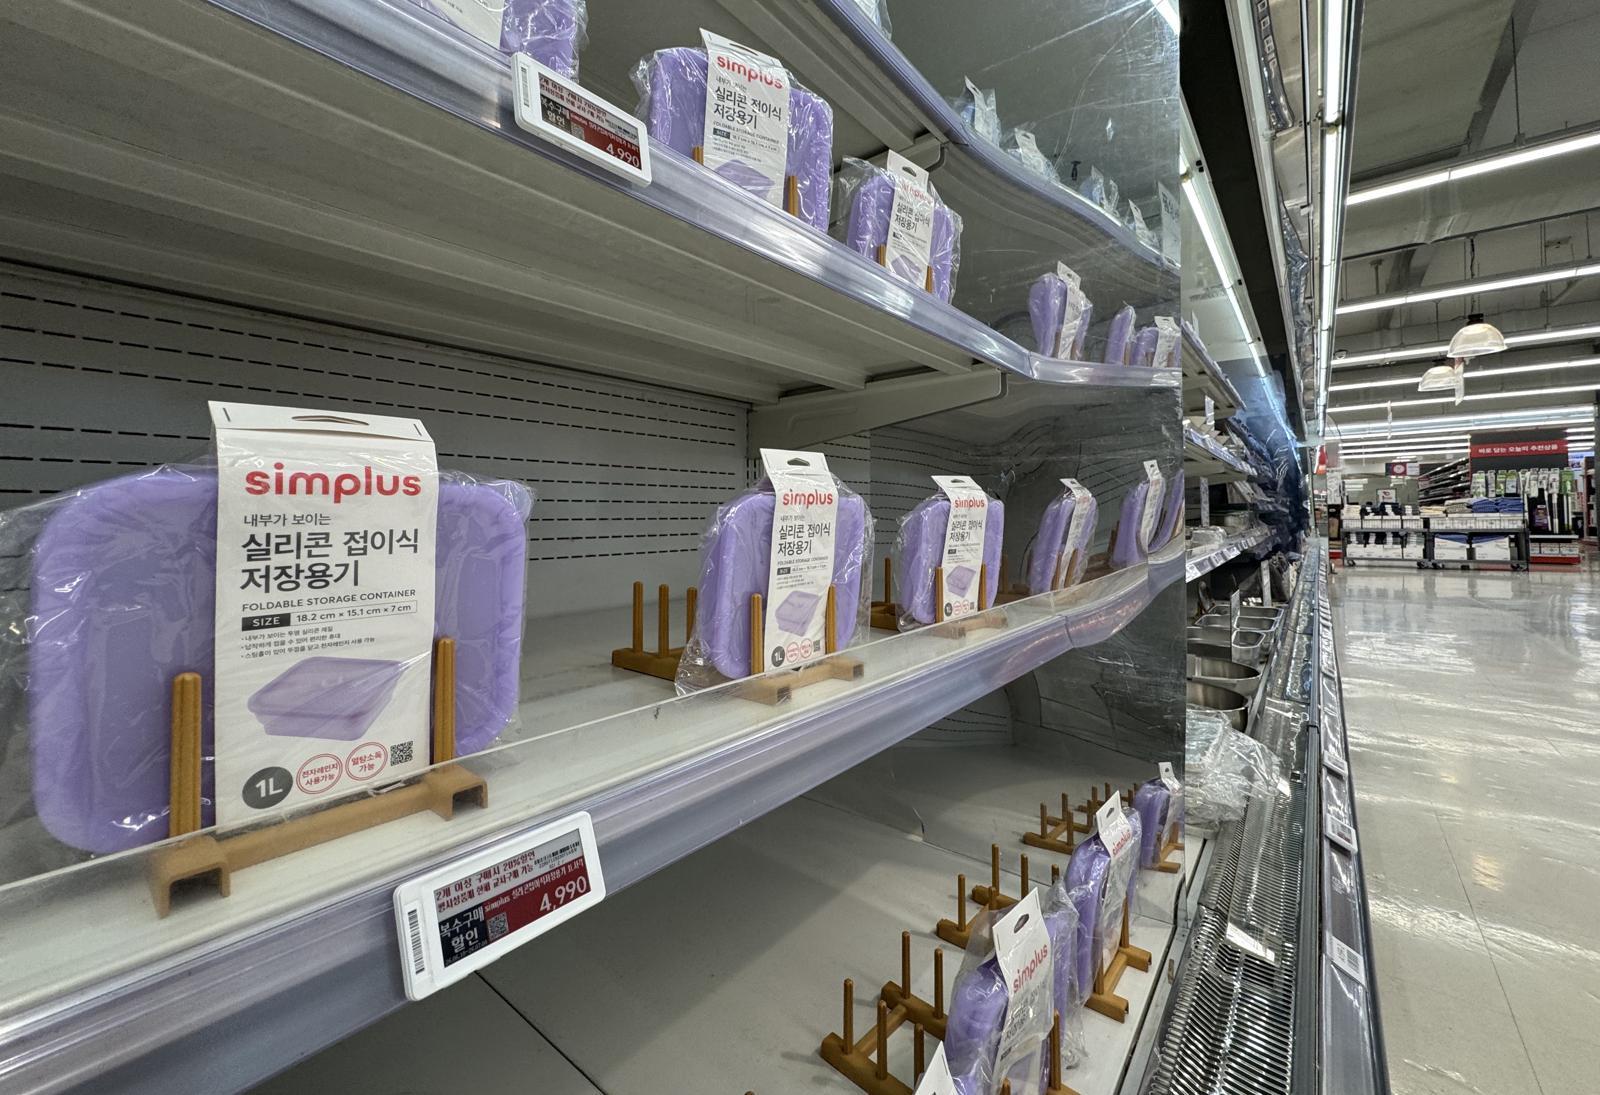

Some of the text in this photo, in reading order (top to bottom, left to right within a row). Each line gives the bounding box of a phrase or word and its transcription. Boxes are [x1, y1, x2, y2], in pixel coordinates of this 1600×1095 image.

[717, 55, 783, 90] simplus
[715, 86, 747, 110] 실리콘
[714, 102, 757, 129] 저장용기
[606, 143, 640, 168] 4,990
[245, 462, 421, 503] simplus
[783, 488, 833, 509] simplus
[244, 513, 331, 527] 내부가 보이는
[779, 522, 831, 540] 실리콘 접이식
[241, 528, 419, 562] 실리콘 접이식
[778, 539, 812, 556] 저장용기
[239, 560, 359, 594] 저장용기
[242, 589, 416, 612] FOLDABLE STORAGE CONTAINER
[252, 616, 280, 627] SIZE
[296, 613, 317, 622] 18.2
[347, 608, 364, 617] 15.1
[302, 763, 338, 778] 전자레인지
[359, 763, 375, 772] 가능
[255, 778, 283, 798] 1L
[305, 774, 335, 786] 사용가능
[521, 863, 534, 875] 가능
[436, 886, 451, 901] 2개
[454, 878, 472, 892] 이상
[476, 866, 500, 883] 구매시
[540, 876, 587, 911] 4,990
[485, 896, 510, 912] simplus
[440, 906, 485, 938] 복수구매
[451, 927, 479, 953] 할인
[1013, 944, 1048, 993] simplus
